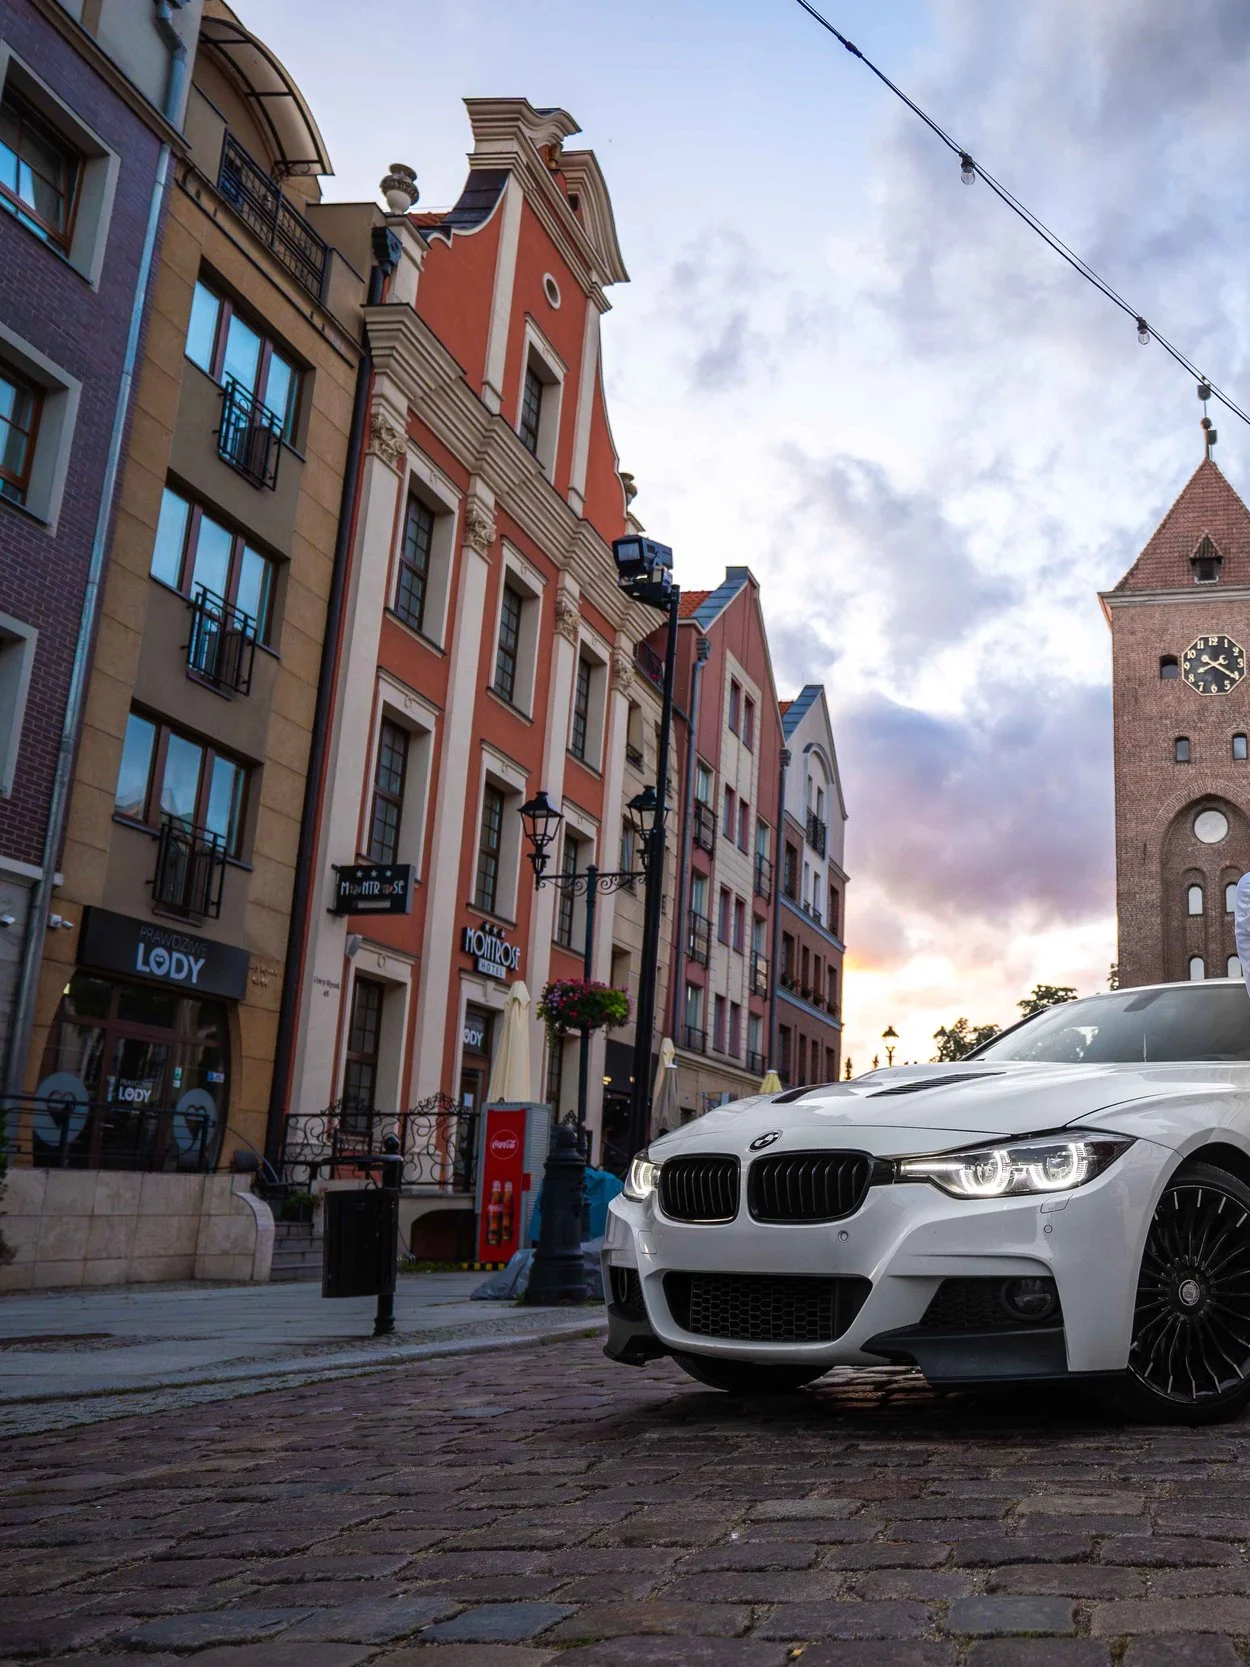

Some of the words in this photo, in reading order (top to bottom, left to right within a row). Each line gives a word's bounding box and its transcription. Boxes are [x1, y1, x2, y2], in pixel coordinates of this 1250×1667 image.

[1196, 640, 1204, 649] 11
[1208, 637, 1218, 646] 12
[1224, 639, 1228, 648] 1
[1187, 650, 1196, 659] 10
[1232, 647, 1239, 656] 2
[1183, 662, 1190, 671] 9
[1237, 658, 1244, 668] 3
[1188, 674, 1195, 683] 8
[1198, 682, 1204, 691] 7
[1210, 684, 1218, 693] 6
[1224, 680, 1230, 690] 5
[465, 927, 520, 970] MONTROSE
[136, 942, 206, 983] LODY
[481, 960, 503, 977] HOTEL
[463, 1028, 484, 1047] ODY
[118, 1086, 152, 1102] LODY
